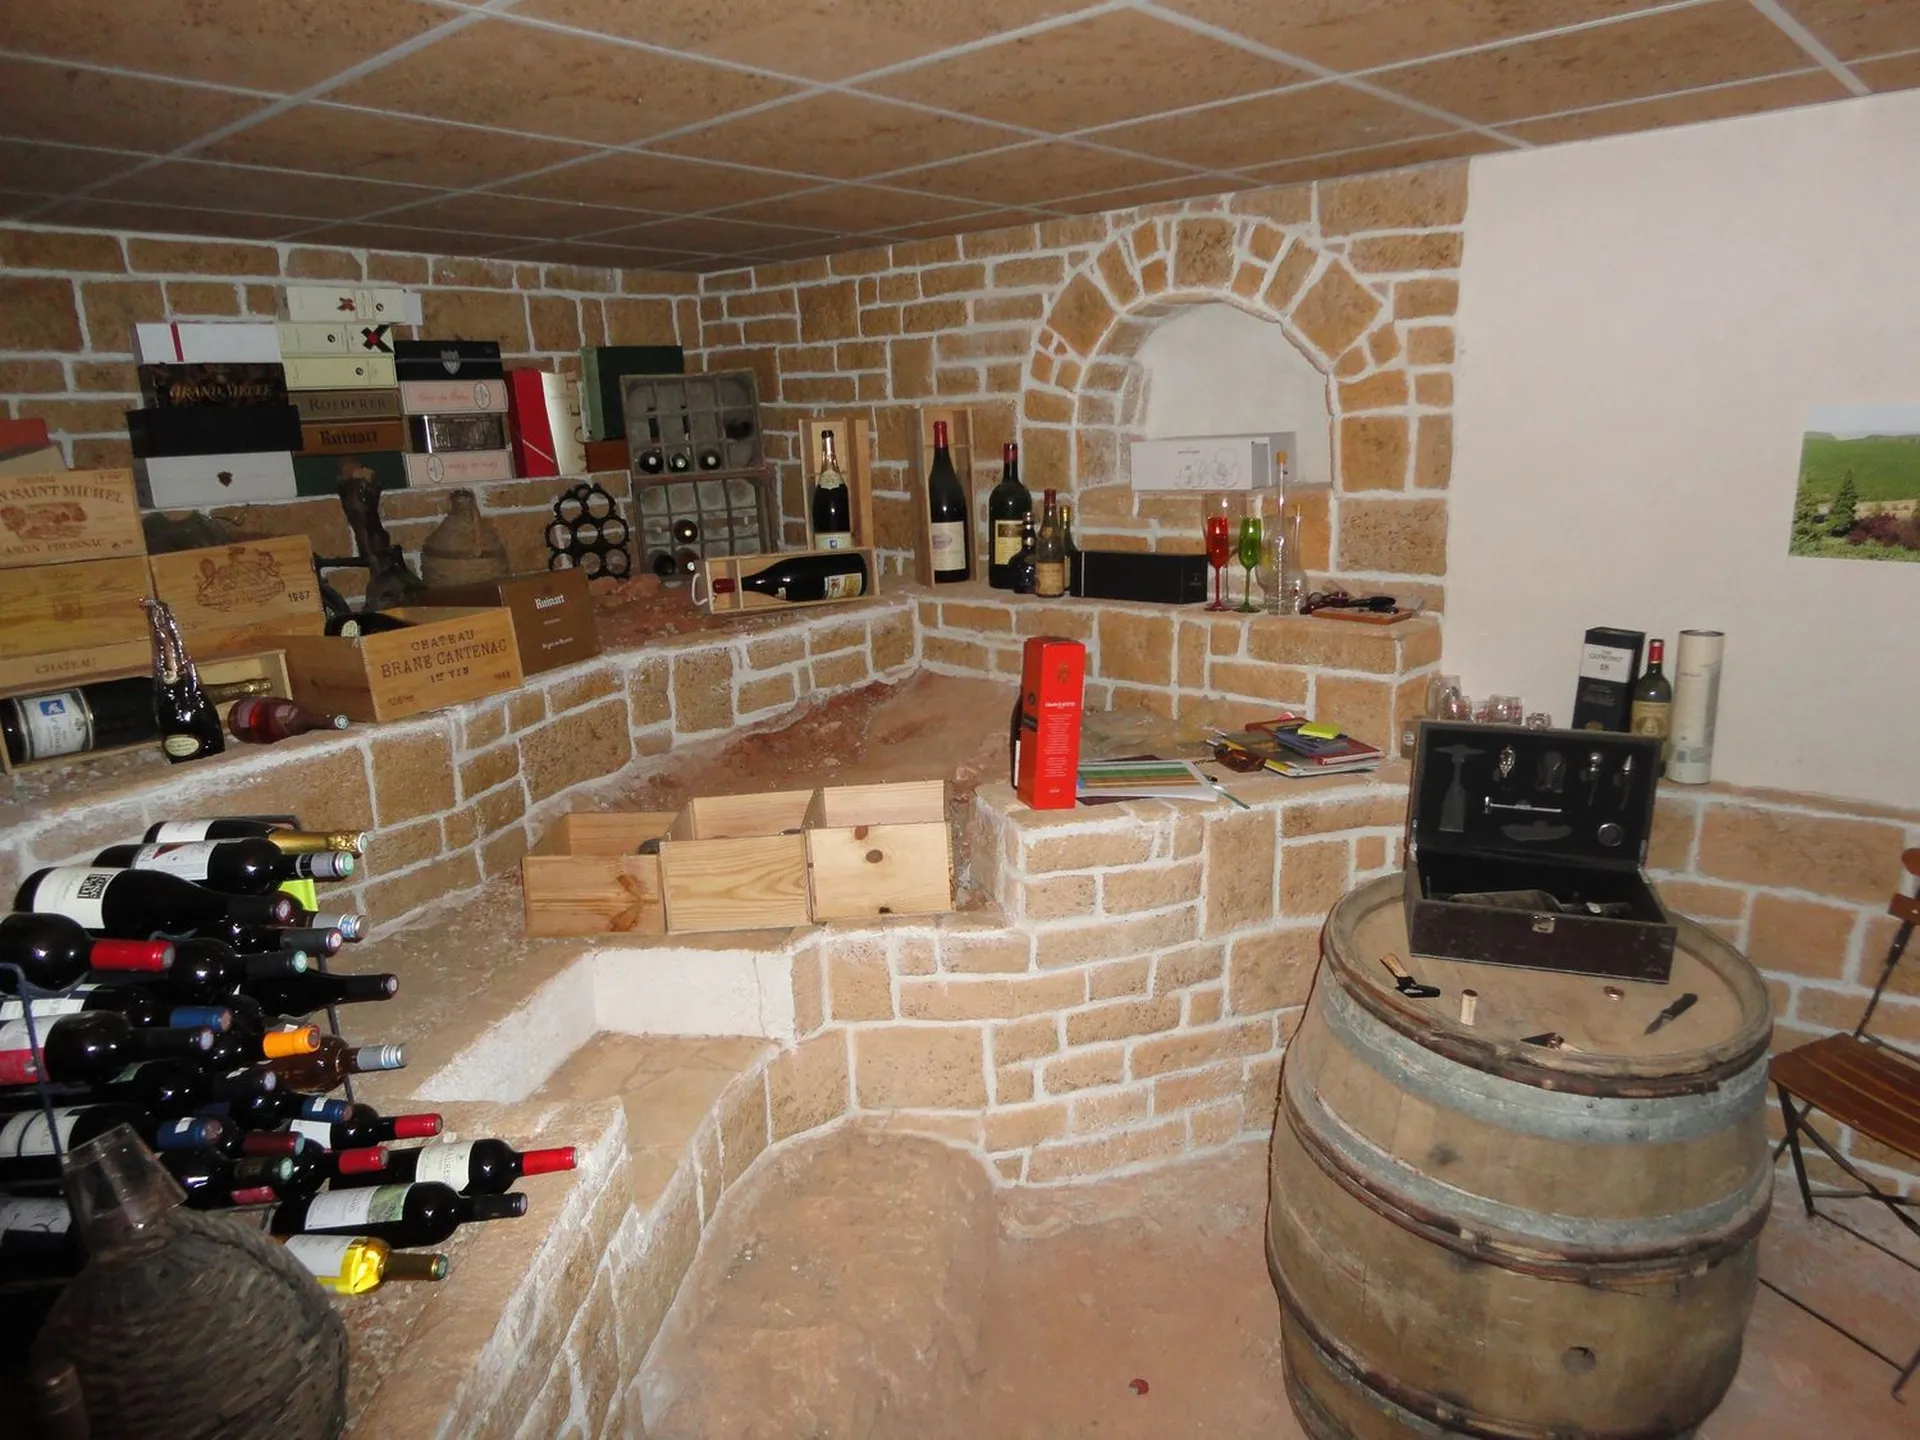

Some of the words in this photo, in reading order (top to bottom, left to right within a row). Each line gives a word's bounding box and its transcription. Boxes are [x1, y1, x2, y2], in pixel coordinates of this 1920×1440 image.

[320, 429, 379, 446] Ruinart
[10, 485, 59, 500] SAINT
[63, 484, 125, 504] MICHEL
[411, 629, 475, 652] CHATEAU
[380, 654, 433, 680] BRANE
[436, 638, 508, 665] CANTENAC
